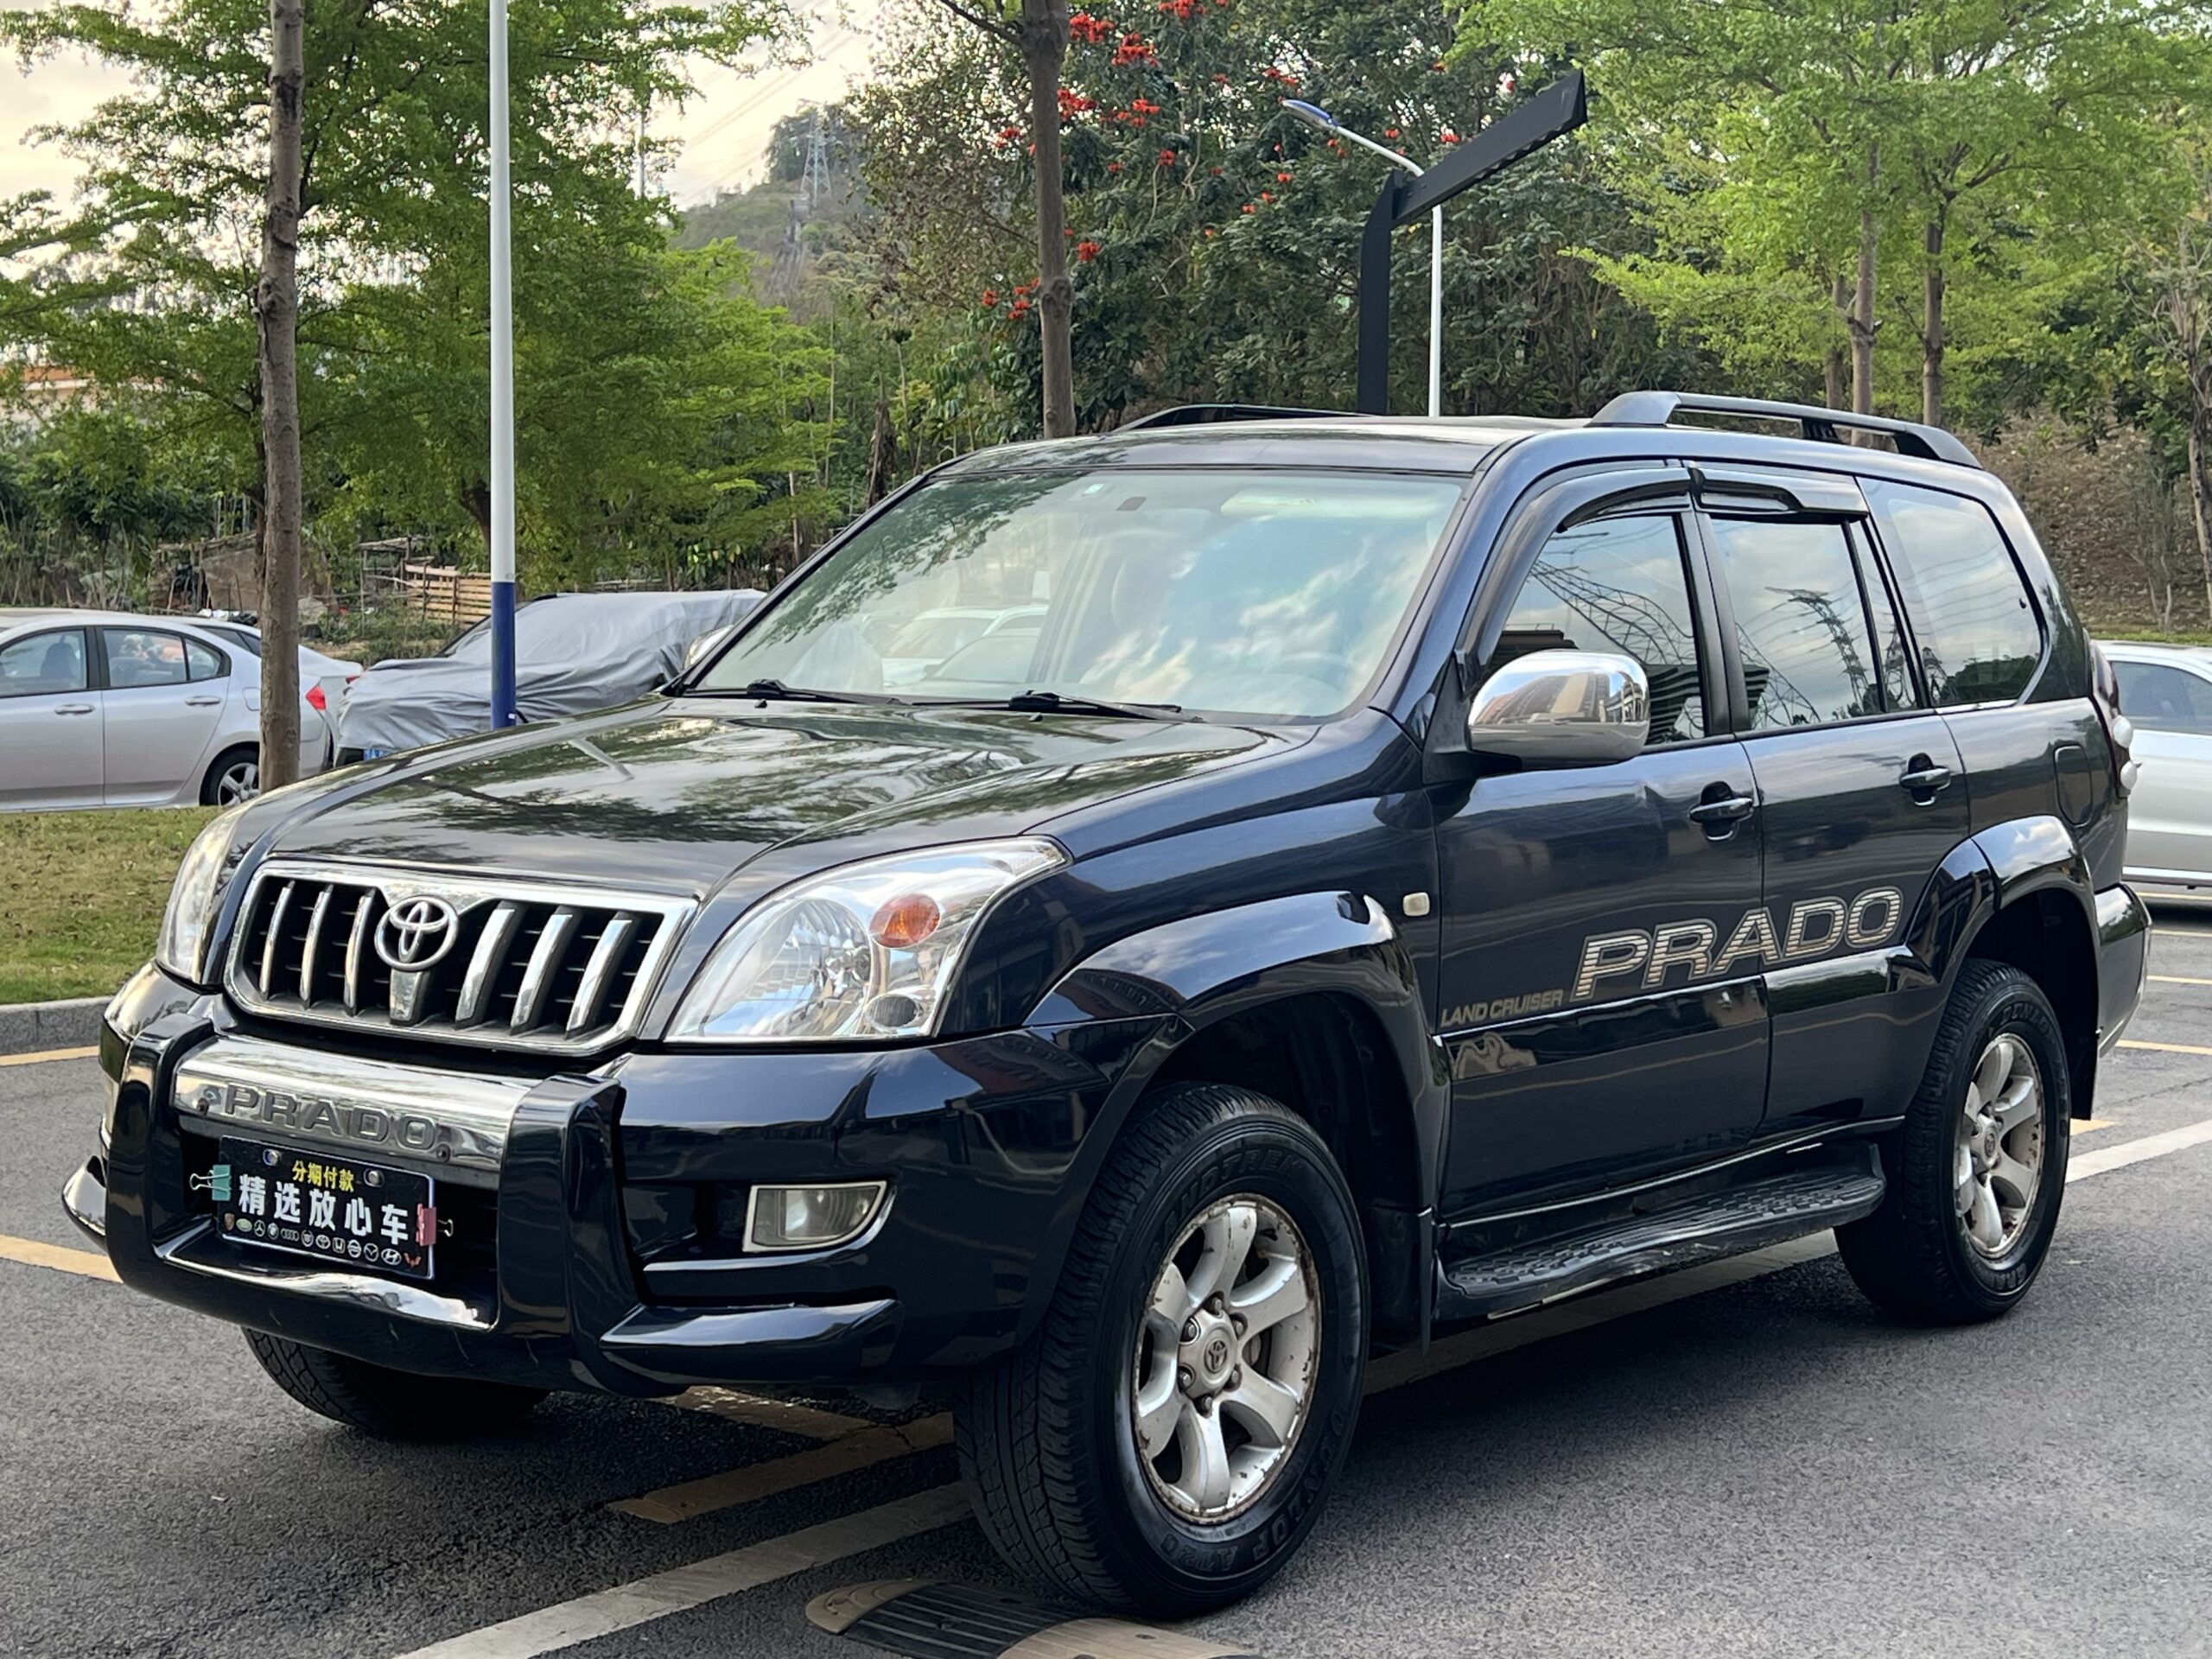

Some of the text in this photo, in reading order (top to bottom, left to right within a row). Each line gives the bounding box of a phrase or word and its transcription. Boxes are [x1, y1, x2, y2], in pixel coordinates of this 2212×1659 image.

[1440, 885, 1903, 1028] LAND CRUISER PRADO
[224, 1084, 437, 1151] PRADO
[238, 1174, 409, 1245] 精选放心车
[292, 1160, 355, 1192] 分期付款
[1160, 1403, 1346, 1572] DUNLOP AT20
